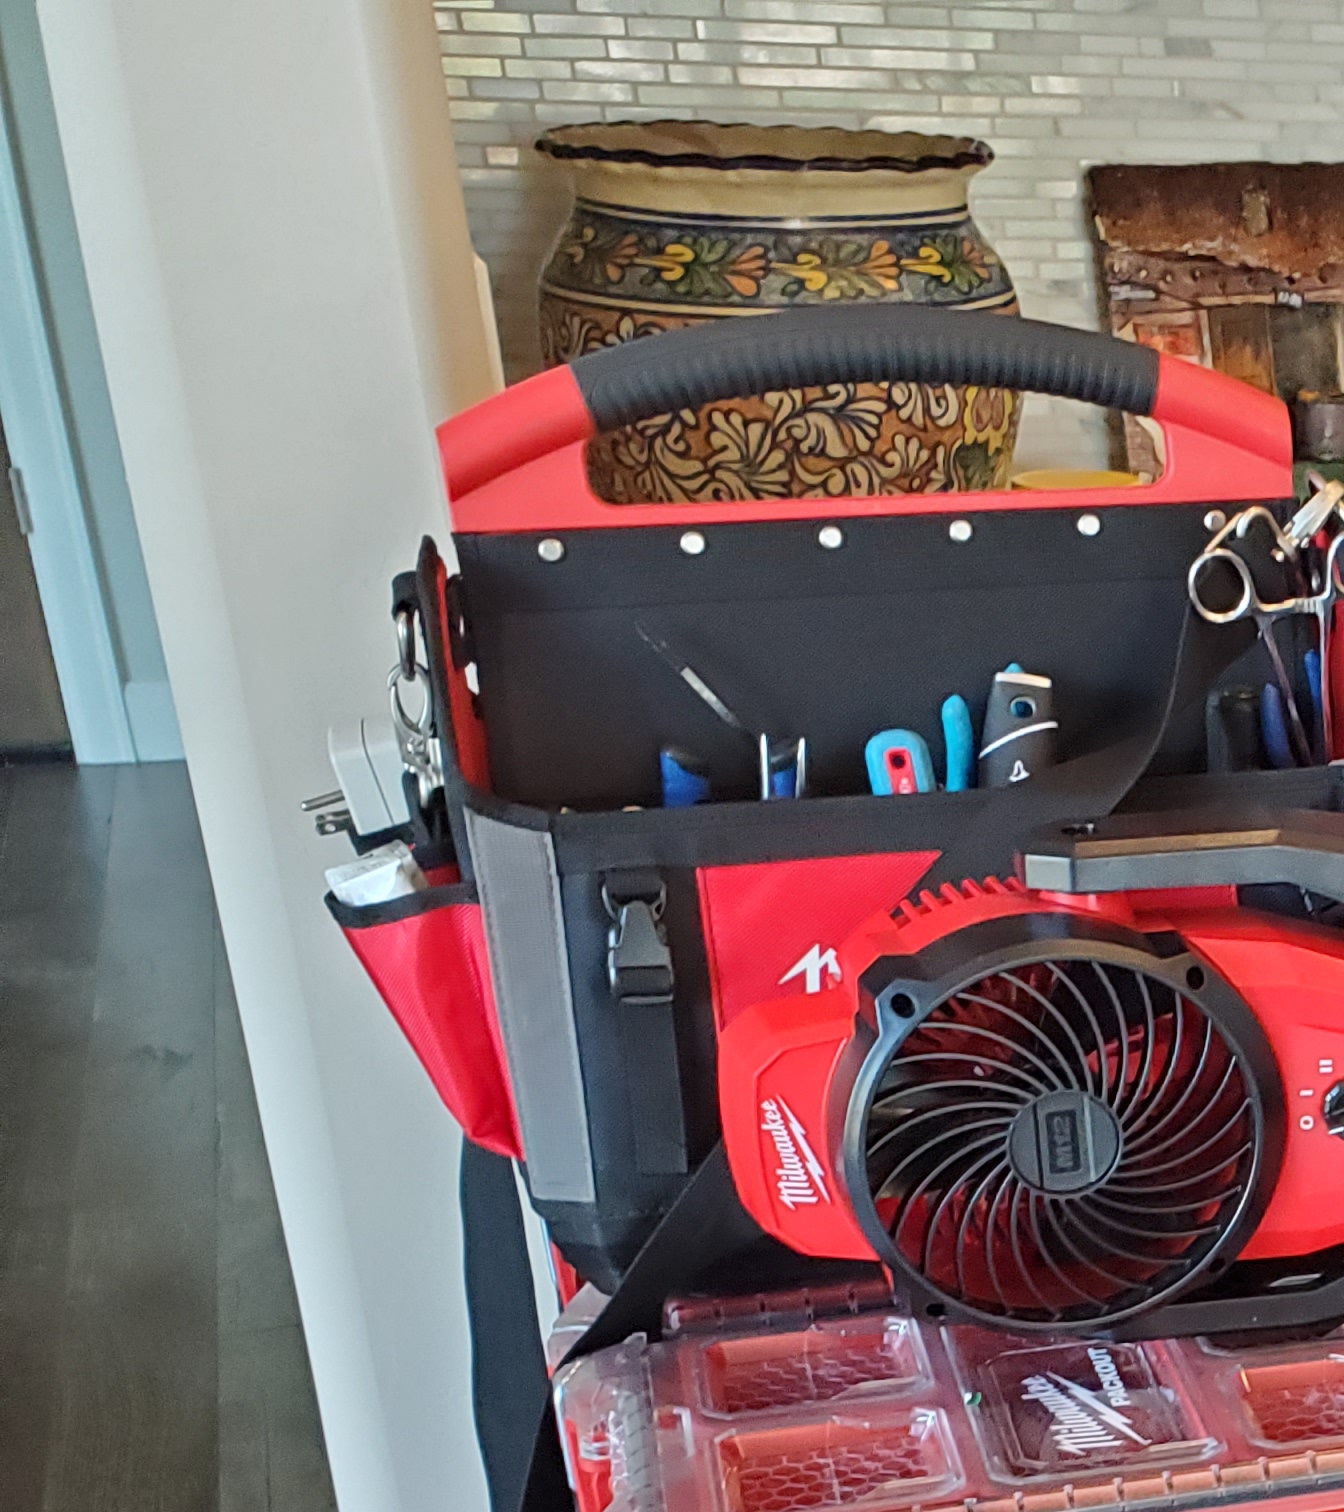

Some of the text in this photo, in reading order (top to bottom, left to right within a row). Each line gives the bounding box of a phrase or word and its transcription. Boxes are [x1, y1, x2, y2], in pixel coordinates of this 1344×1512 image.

[761, 1098, 819, 1211] Milwaukee
[1020, 1374, 1125, 1456] Milwaukee
[1087, 1347, 1131, 1407] PACKOUT
